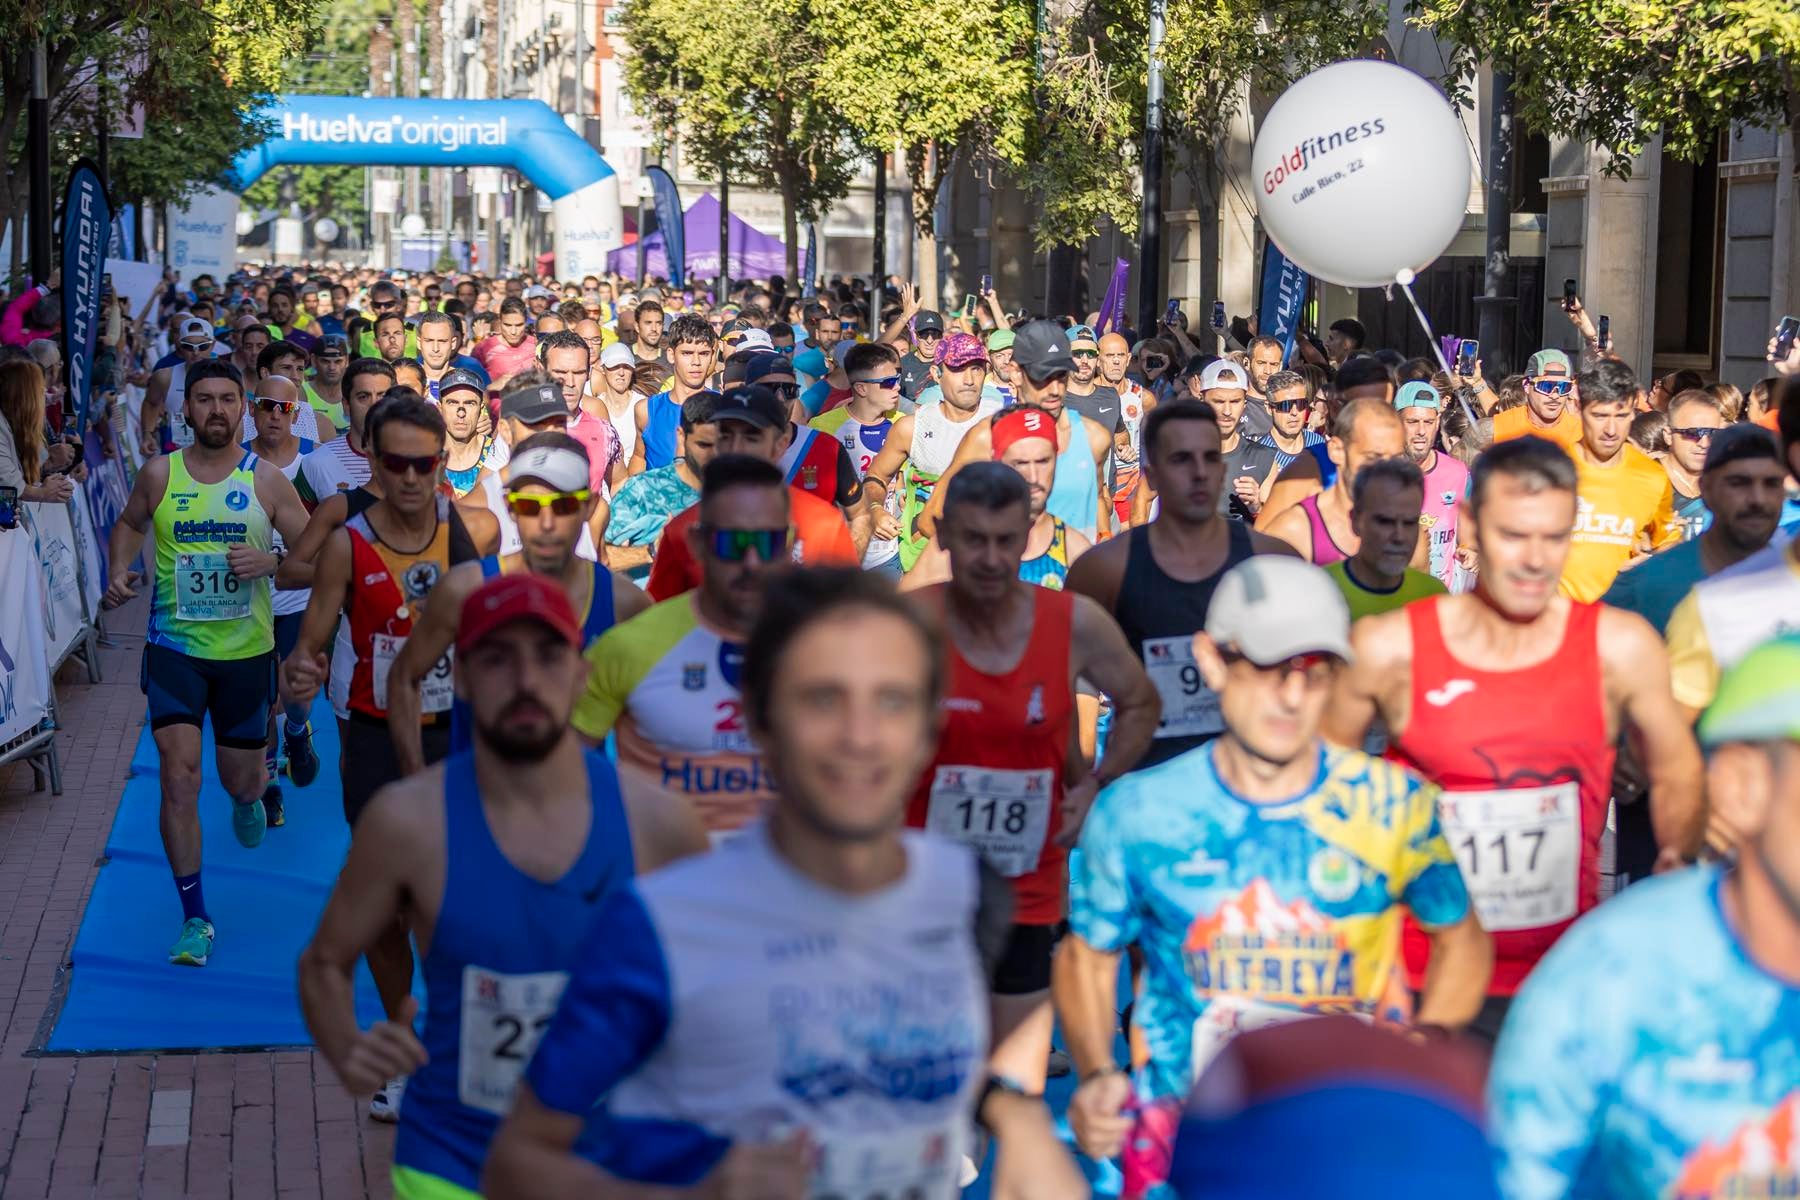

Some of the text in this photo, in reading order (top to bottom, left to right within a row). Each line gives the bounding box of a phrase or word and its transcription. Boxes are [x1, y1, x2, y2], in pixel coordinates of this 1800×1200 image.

[283, 112, 507, 152] Huelva original
[1263, 118, 1386, 194] Goldfitness
[1291, 158, 1365, 205] Calle Rico, 22
[563, 228, 611, 241] Huelva
[73, 181, 94, 345] HYUNDAI
[174, 519, 247, 535] Atletismo
[189, 571, 240, 595] 316
[956, 797, 1028, 835] 118
[1461, 830, 1547, 875] 117
[493, 1013, 549, 1062] 2
